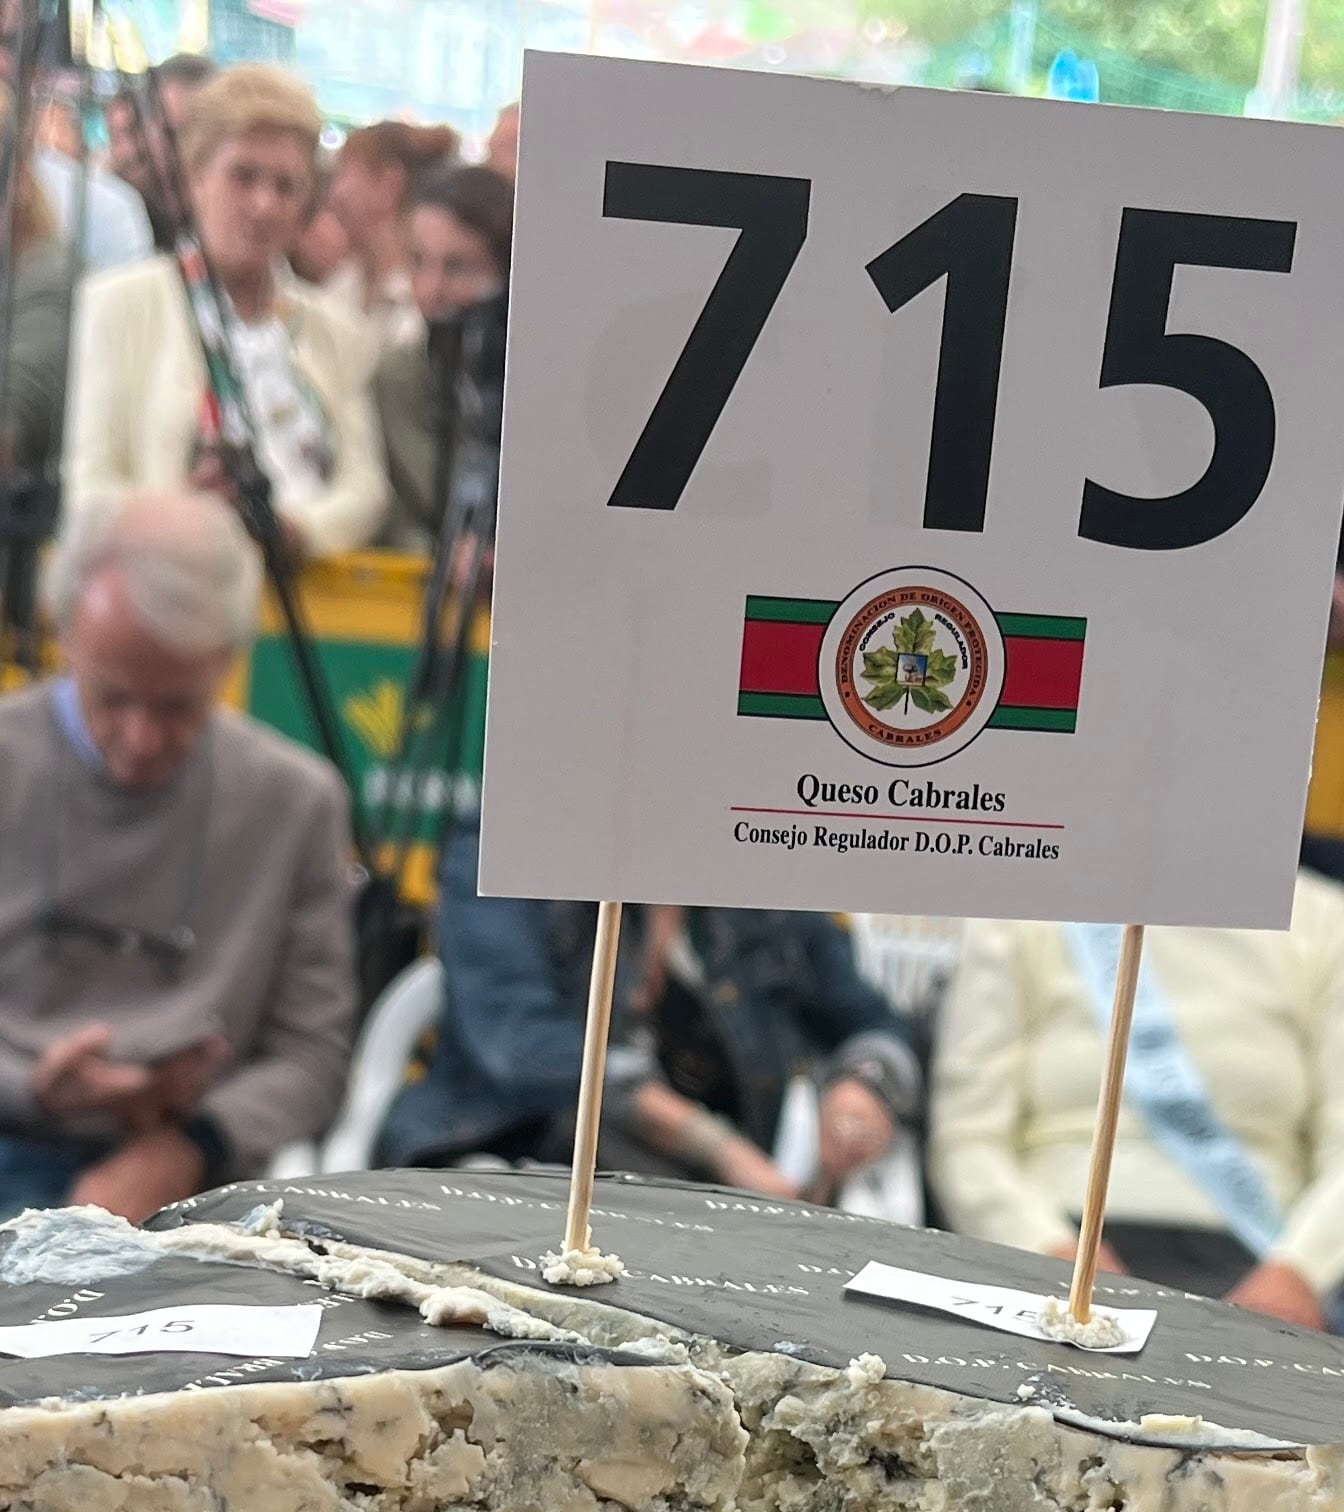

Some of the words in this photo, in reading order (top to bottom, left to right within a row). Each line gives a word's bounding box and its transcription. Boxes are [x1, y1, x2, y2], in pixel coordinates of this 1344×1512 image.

[602, 160, 1297, 551] 715
[900, 591, 917, 602] DE
[920, 594, 966, 622] ORIGEN
[859, 612, 897, 652] CONSEJO
[934, 613, 969, 670] REGULADOR
[868, 723, 943, 744] CABRALES
[797, 774, 879, 808] Queso
[888, 779, 1006, 812] Cabrales
[734, 822, 808, 849] Consejo
[813, 826, 910, 853] Regulador
[915, 833, 973, 856] D.O.P.
[978, 836, 1059, 860] Cabrales
[621, 1268, 810, 1296] CABRALES
[951, 1296, 1039, 1321] 715
[89, 1319, 196, 1344] 715
[1016, 1361, 1213, 1390] CABRALES
